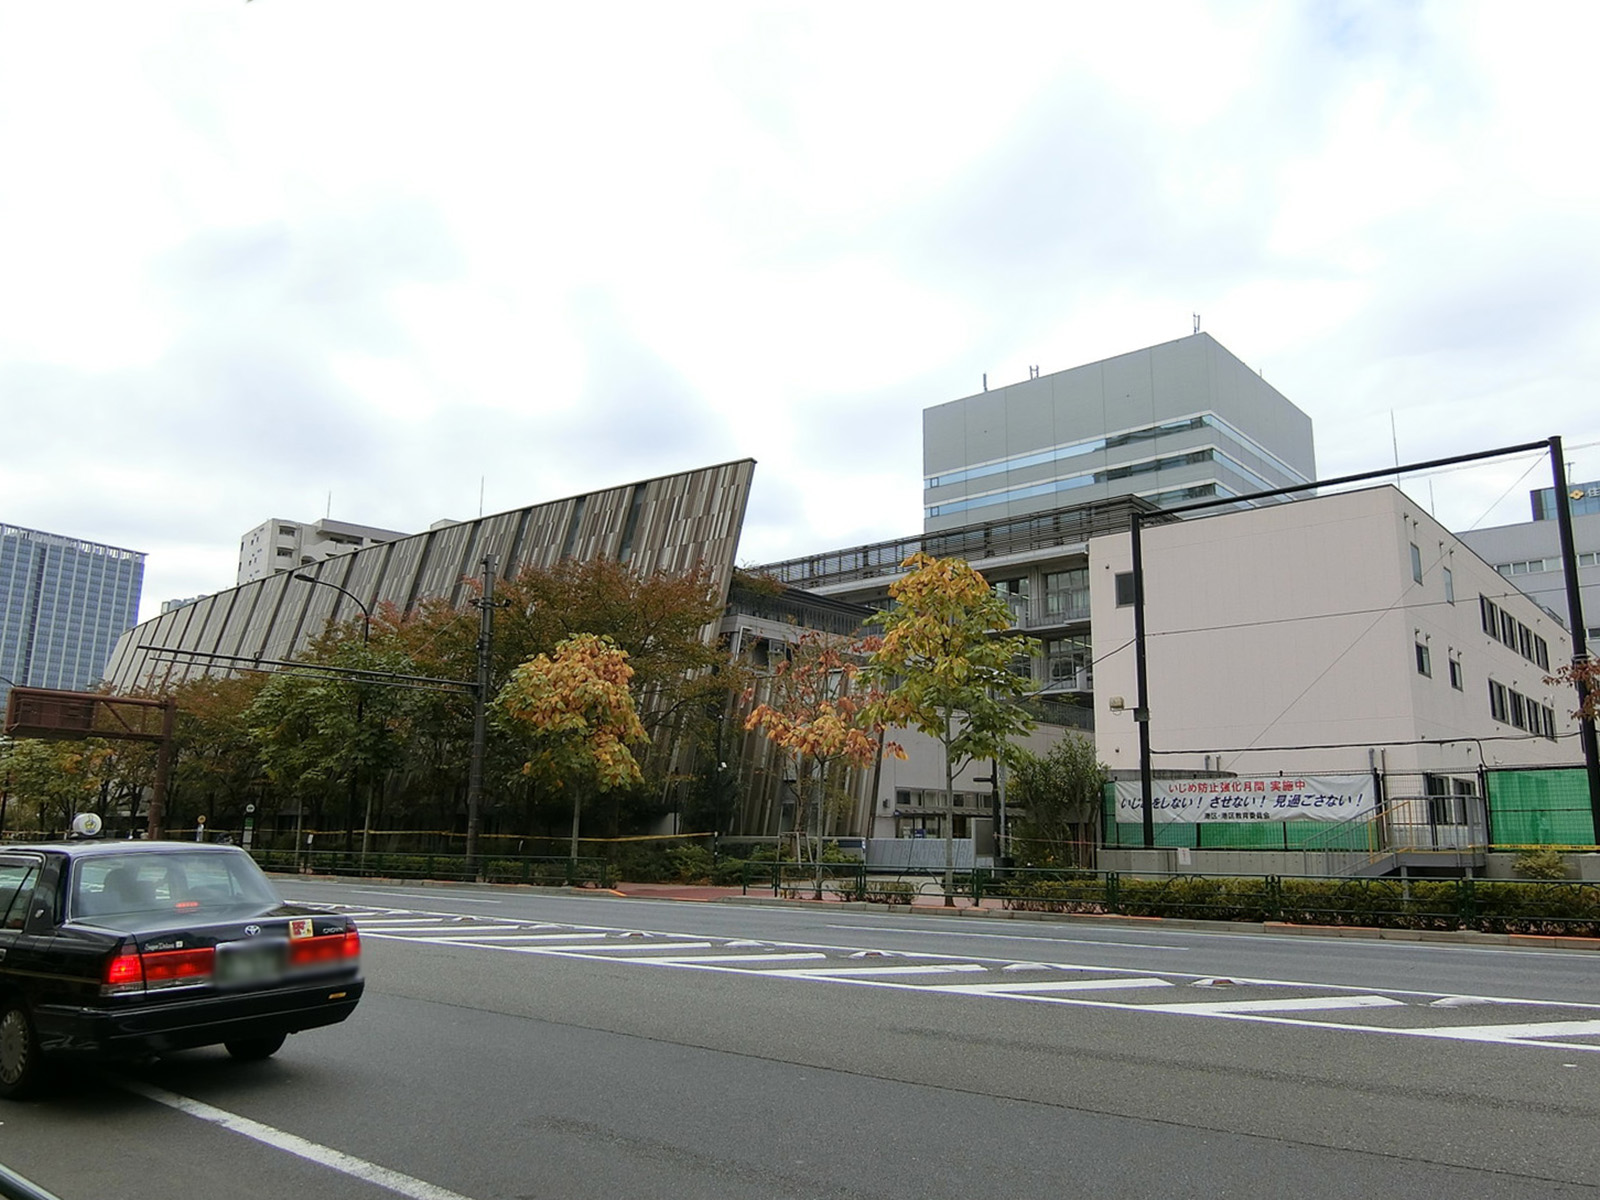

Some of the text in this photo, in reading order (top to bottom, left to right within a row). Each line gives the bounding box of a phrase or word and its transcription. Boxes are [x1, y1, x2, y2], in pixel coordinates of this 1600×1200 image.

[1168, 780, 1306, 793] いじめ防止強化月間 実施中
[1121, 793, 1363, 810] いじをしない！ させない！ 見過ごさない！
